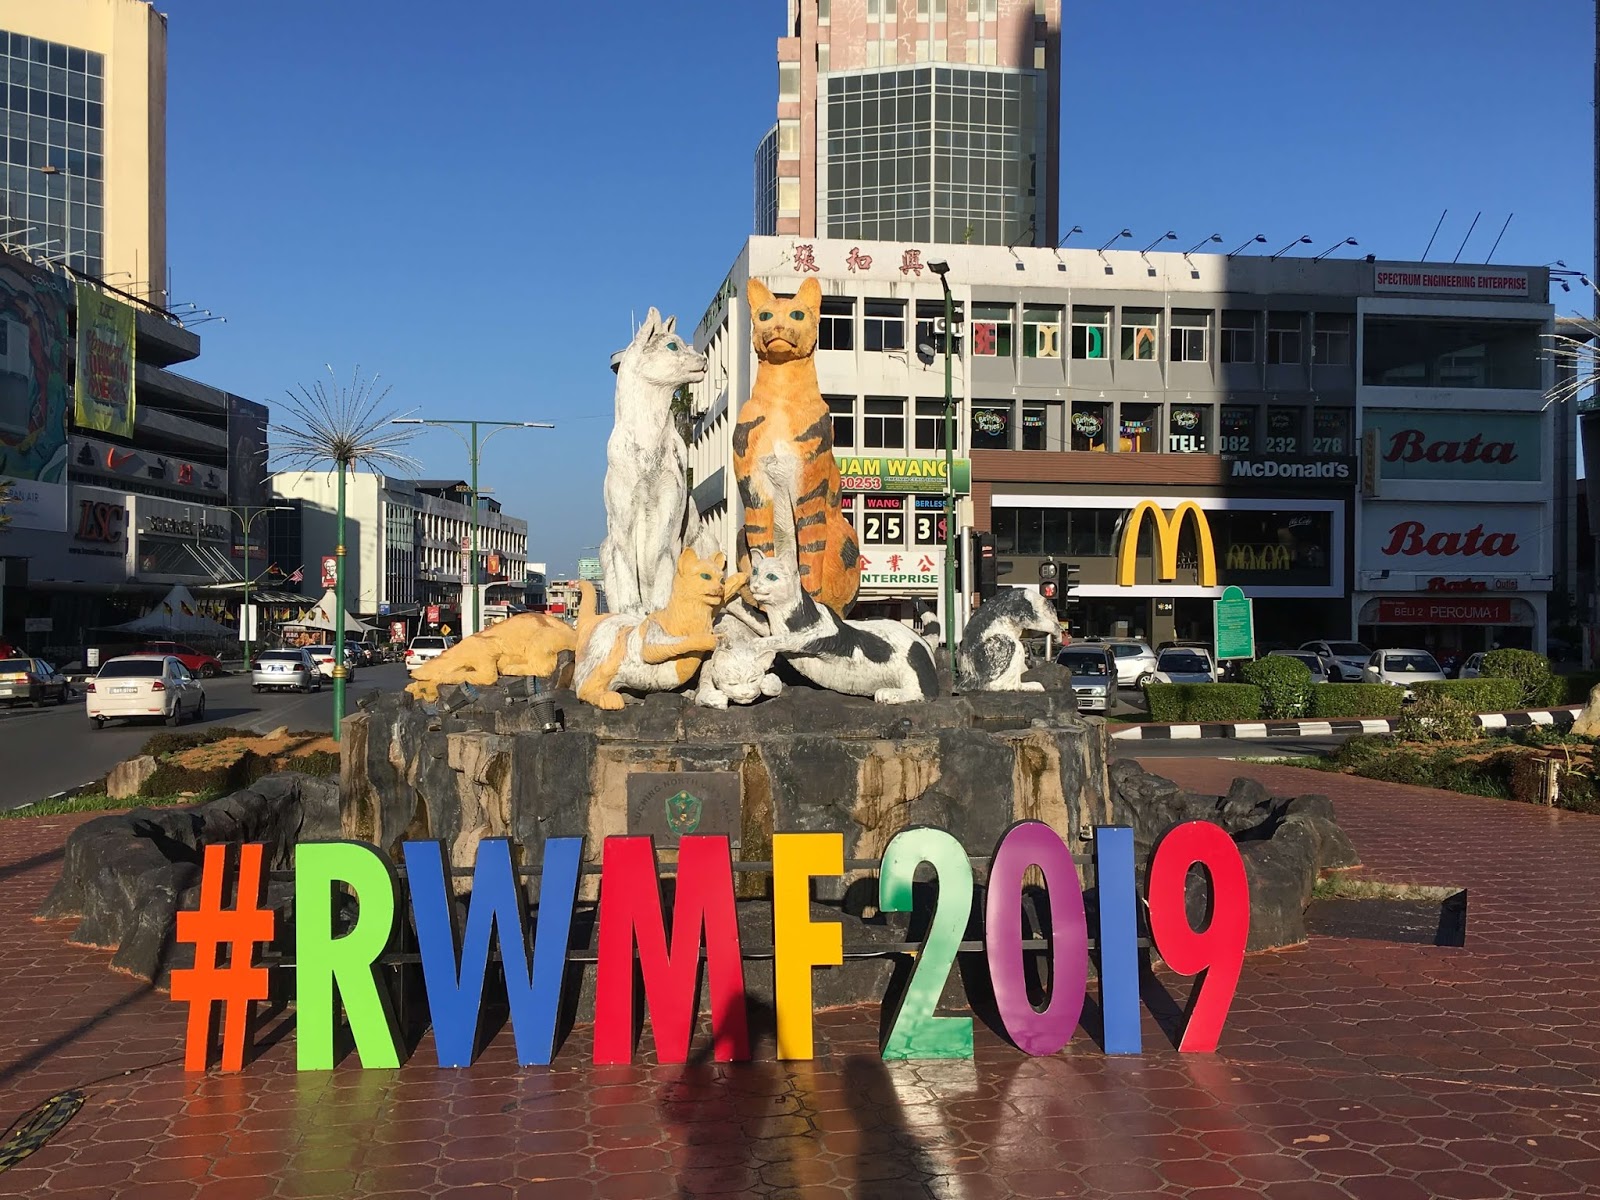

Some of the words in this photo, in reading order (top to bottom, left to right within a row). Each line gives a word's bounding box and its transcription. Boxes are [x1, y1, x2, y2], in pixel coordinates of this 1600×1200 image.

[1377, 271, 1421, 286] SPECTRUM
[1422, 274, 1476, 288] ENGINEERING
[1477, 276, 1527, 290] ENTERPRISE
[1169, 435, 1205, 451] TEL:
[1218, 436, 1249, 452] 082
[1265, 437, 1296, 453] 232
[1313, 437, 1343, 453] 278
[1382, 429, 1518, 465] Bata
[840, 457, 881, 476] JAM
[1231, 460, 1349, 478] McDonald's
[867, 499, 900, 508] WANG
[75, 500, 124, 544] LSC
[866, 518, 880, 540] 2
[887, 518, 900, 540] 5
[917, 518, 930, 540] 3
[1381, 520, 1520, 557] Bata
[862, 574, 938, 583] NTERPRISE
[1427, 577, 1488, 593] Bata
[1495, 578, 1518, 589] Outlet
[1394, 607, 1415, 616] BELI
[1417, 607, 1424, 616] 2
[1429, 606, 1492, 619] PERCUMA
[1494, 606, 1500, 619] 1
[170, 820, 1250, 1073] #RWMF2019
